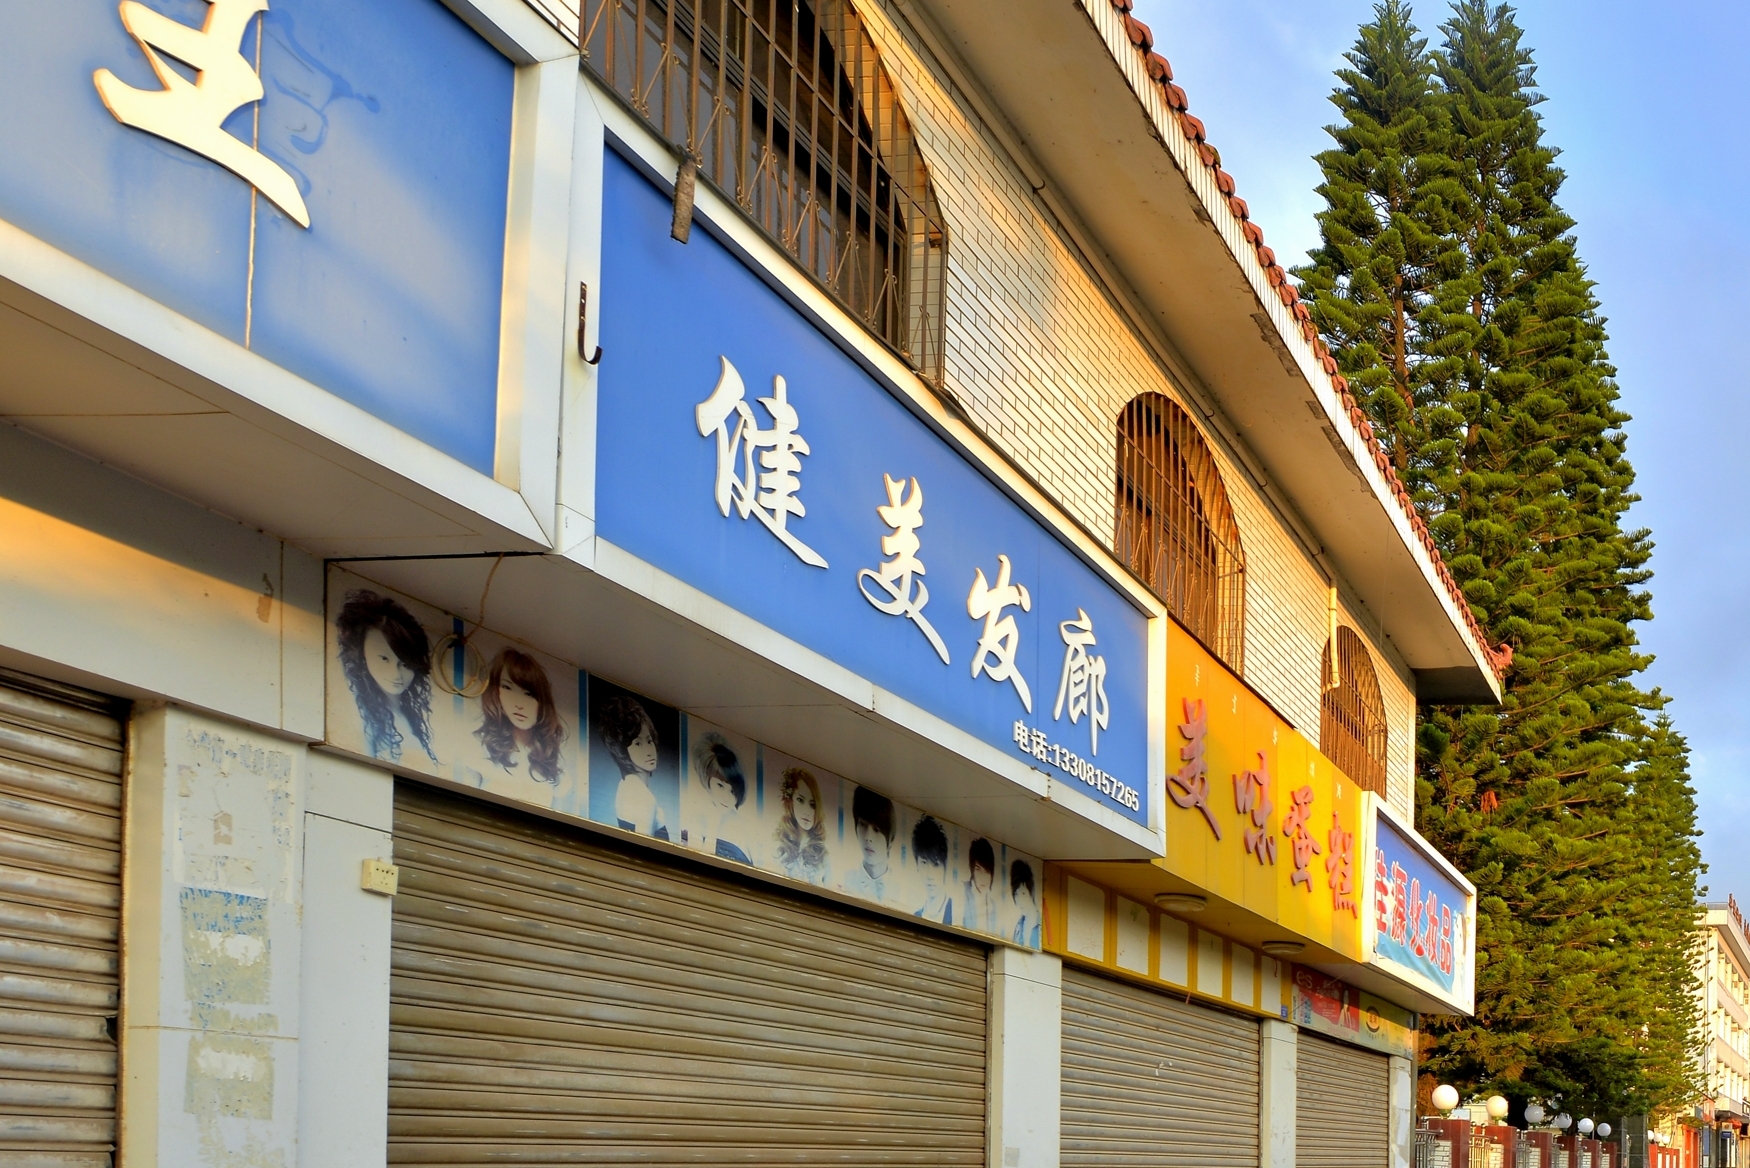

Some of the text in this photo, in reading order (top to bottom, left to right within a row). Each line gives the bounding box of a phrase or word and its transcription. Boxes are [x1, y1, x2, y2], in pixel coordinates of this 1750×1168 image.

[696, 355, 1109, 756] 健美发廊
[1166, 697, 1358, 919] 美味蛋糕
